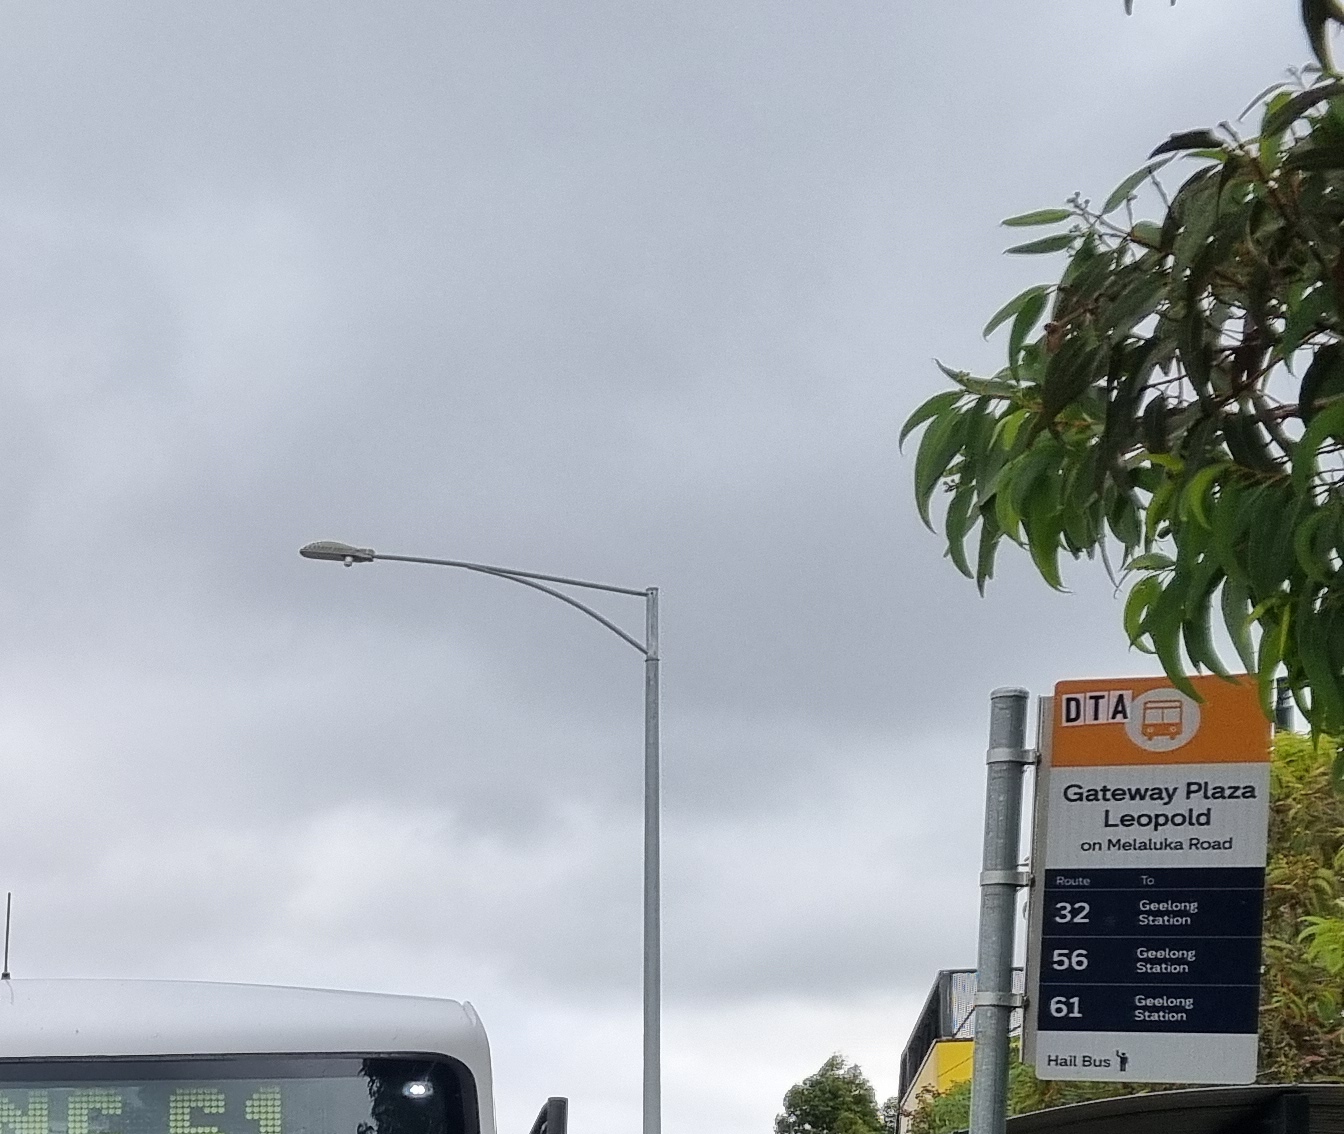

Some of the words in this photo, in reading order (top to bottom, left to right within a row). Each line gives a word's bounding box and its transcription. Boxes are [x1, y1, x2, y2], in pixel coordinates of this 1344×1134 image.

[1063, 783, 1179, 805] Gateway
[1185, 781, 1257, 800] Plaza
[1104, 807, 1212, 831] Leopold
[1080, 841, 1102, 851] on
[1107, 838, 1184, 851] Melaluka
[1189, 837, 1233, 851] Road
[1056, 876, 1091, 886] Route
[1141, 875, 1155, 885] To
[1055, 902, 1090, 923] 32
[1139, 900, 1198, 913] Geelong
[1139, 914, 1191, 925] Station
[1052, 949, 1088, 970] 56
[1136, 948, 1196, 961] Geelong
[1136, 962, 1189, 973] Station
[1050, 996, 1083, 1018] 61
[1134, 995, 1194, 1009] Geelong
[1134, 1010, 1187, 1021] Station
[1047, 1055, 1077, 1068] Hail
[1082, 1055, 1111, 1068] Bus
